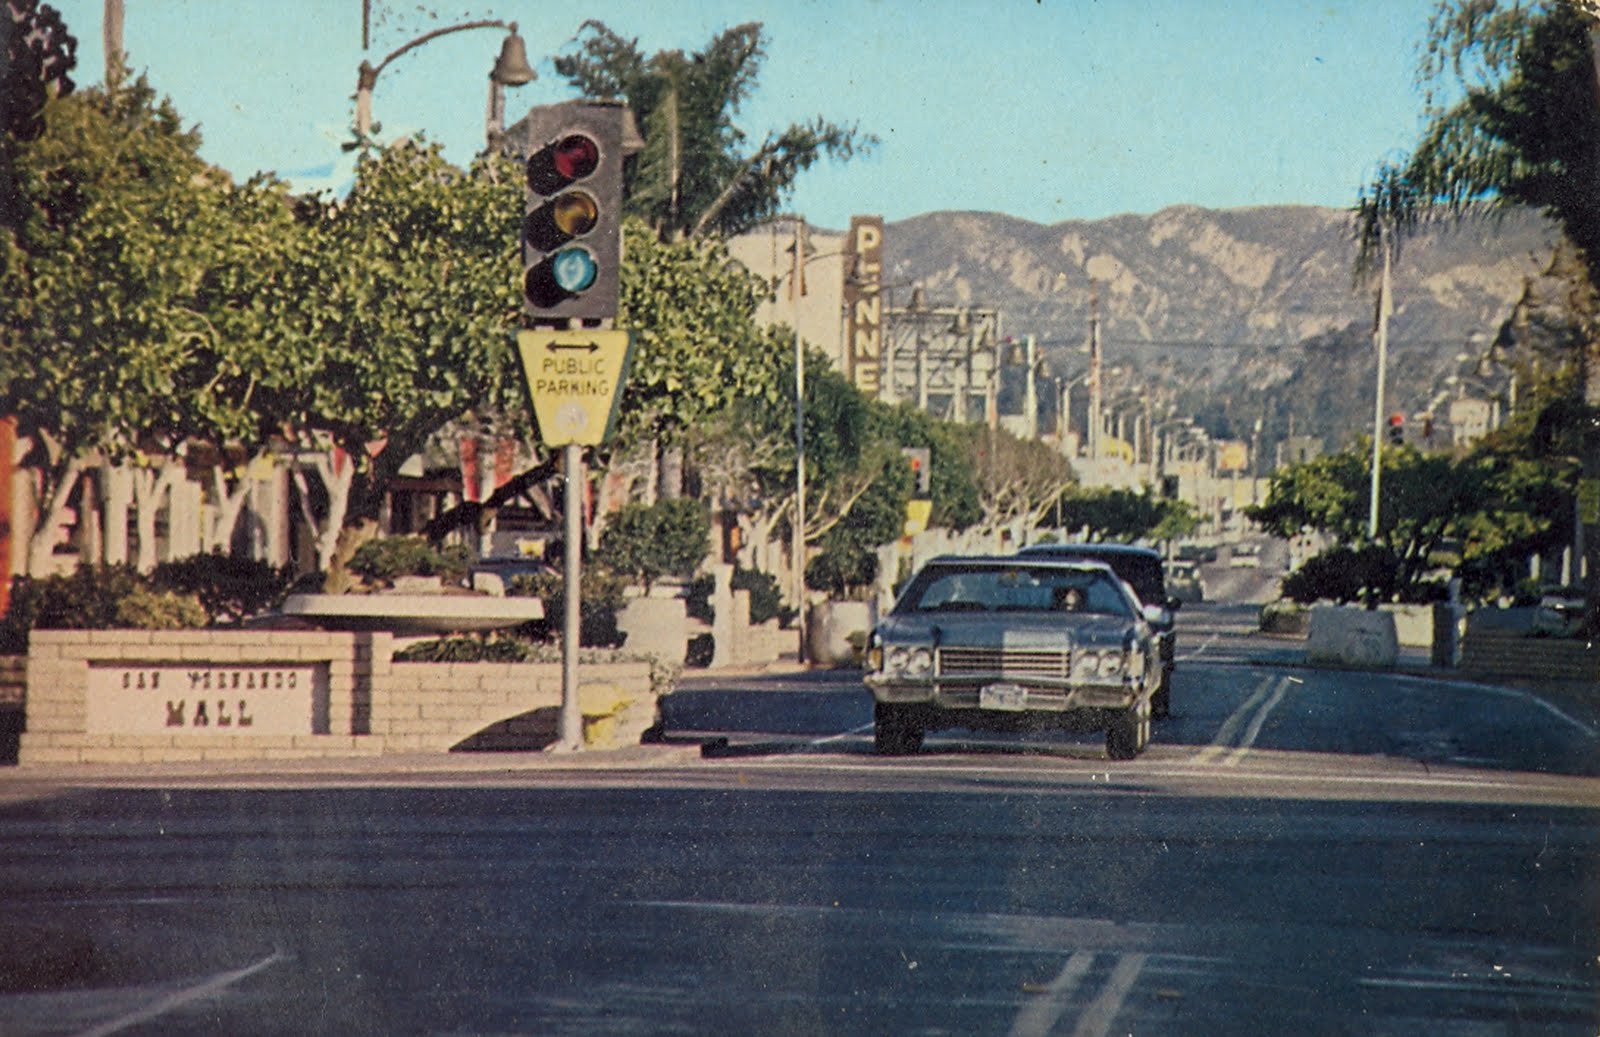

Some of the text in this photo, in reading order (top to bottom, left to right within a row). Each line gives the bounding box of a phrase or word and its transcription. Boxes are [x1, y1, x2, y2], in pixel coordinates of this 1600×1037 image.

[542, 358, 605, 374] PUBLIC
[536, 379, 609, 396] PARKING
[166, 700, 252, 726] MALL
